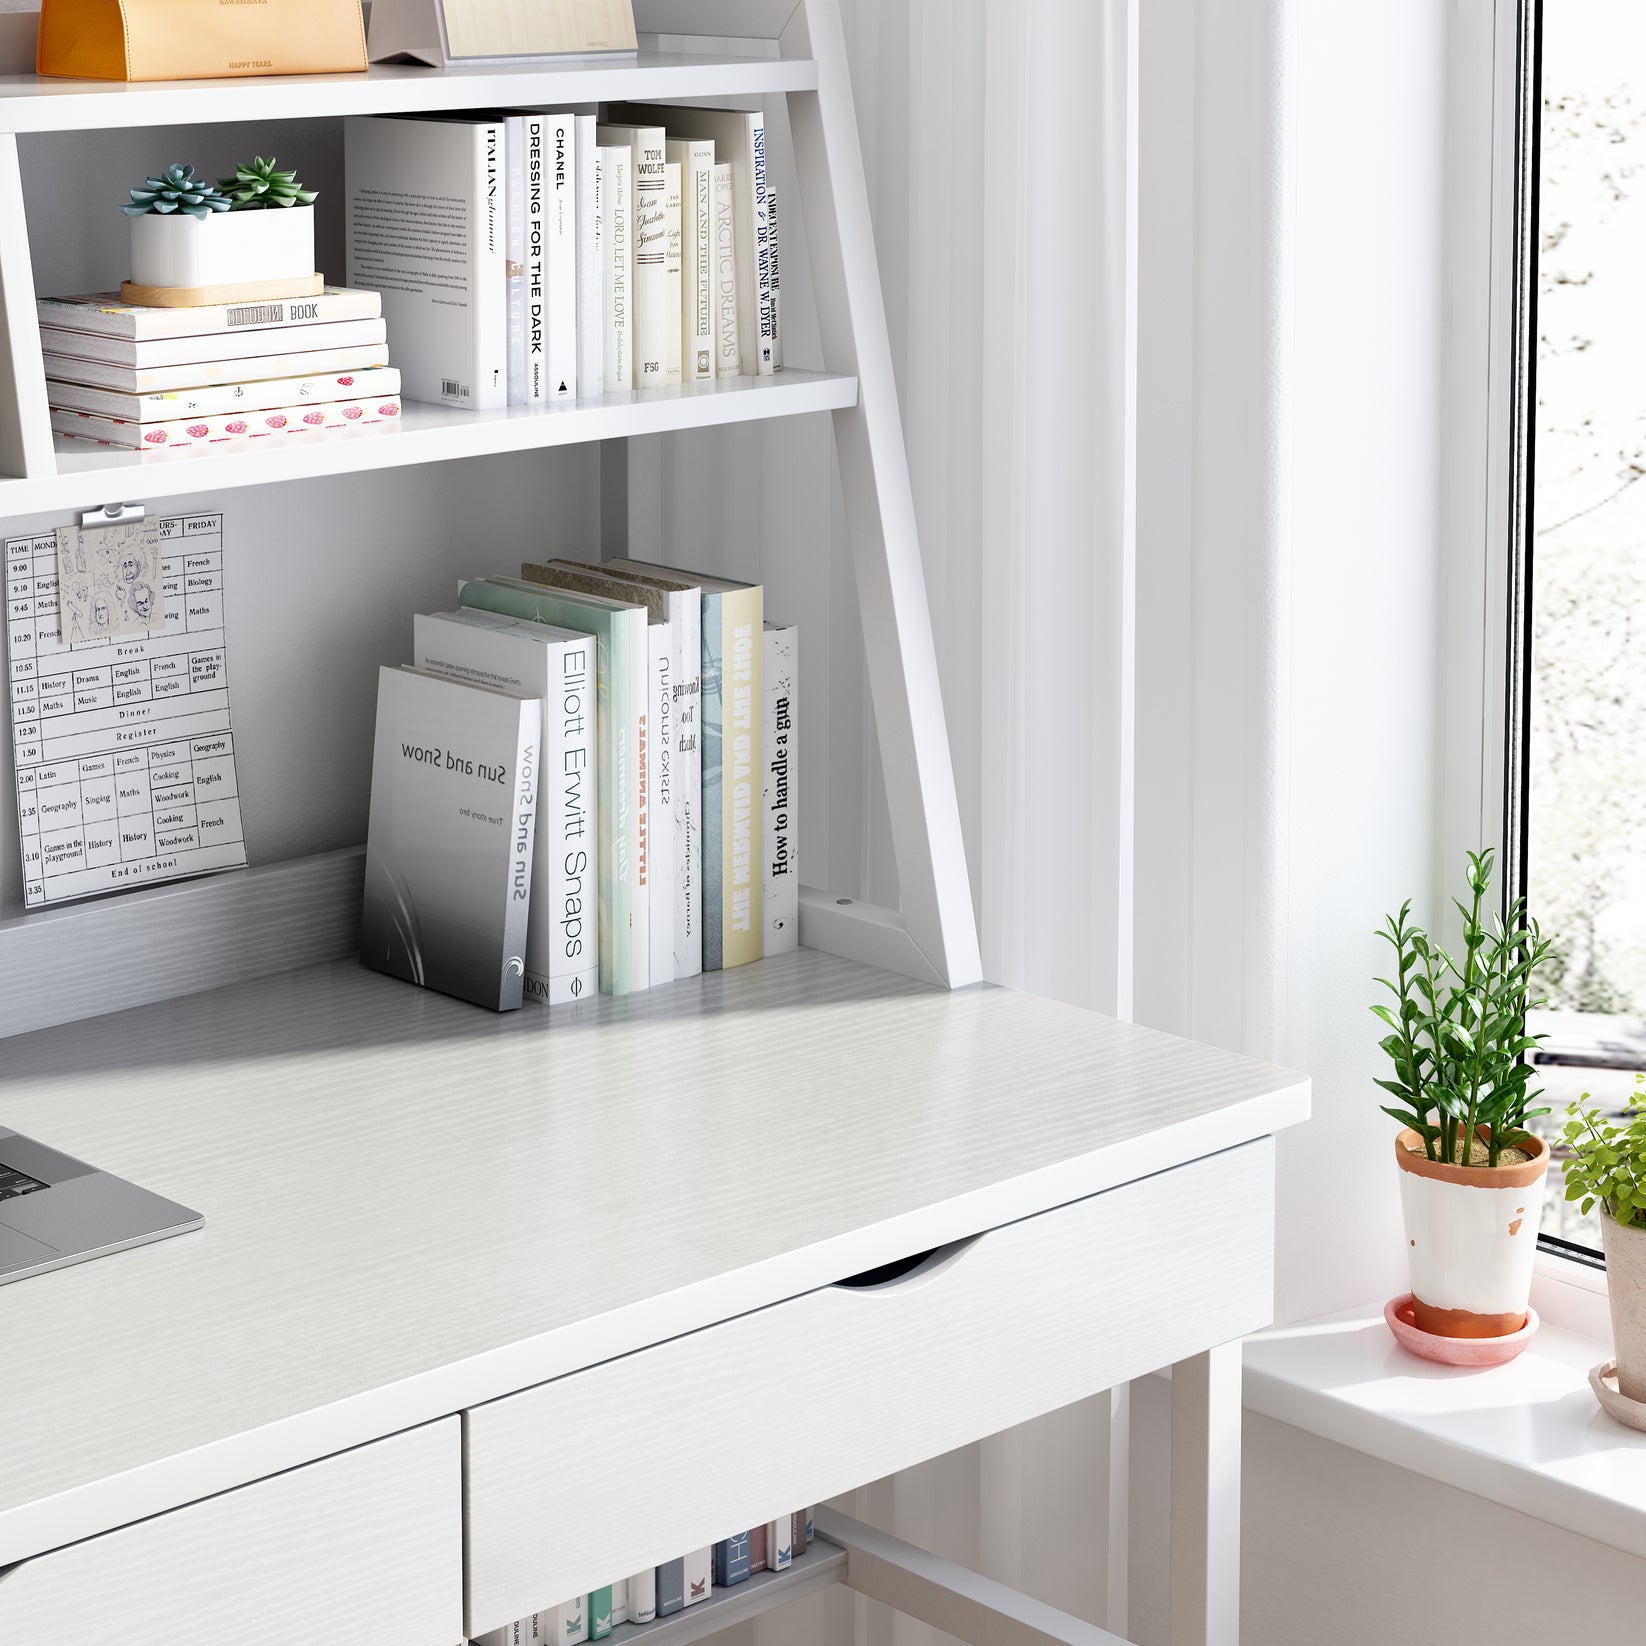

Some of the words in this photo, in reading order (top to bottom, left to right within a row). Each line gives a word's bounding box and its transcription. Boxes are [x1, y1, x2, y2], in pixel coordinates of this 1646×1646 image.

[556, 128, 564, 190] CHANEL
[644, 150, 662, 160] TOM
[486, 128, 497, 198] ITALIAN
[530, 124, 540, 214] DRESSING
[638, 163, 664, 174] WOLFE
[754, 128, 766, 204] INSPIRATION
[768, 194, 778, 241] INDECENT
[613, 209, 624, 245] LORD,
[530, 220, 541, 257] FOR
[718, 201, 733, 274] ARCTIC
[758, 227, 768, 246] DR.
[614, 248, 624, 273] LET
[758, 248, 769, 289] WAYNE
[531, 262, 541, 298] THE
[614, 274, 624, 293] ME
[760, 291, 770, 304] W.
[512, 263, 521, 346] CULTURE
[290, 304, 318, 320] BOOK
[614, 296, 624, 328] LOVE
[718, 281, 737, 358] DREAMS
[760, 307, 771, 338] DYER
[531, 304, 542, 354] DARK
[644, 362, 659, 372] FSG
[160, 521, 177, 529] URS-
[188, 520, 217, 530] FRIDAY
[10, 545, 29, 554] TIME
[34, 541, 57, 550] MOND
[13, 564, 28, 572] 9.00
[187, 559, 210, 567] French
[188, 578, 213, 587] Biology
[14, 585, 28, 593] 9.10
[14, 604, 28, 612] 9.45
[37, 600, 58, 609] Maths
[189, 607, 210, 616] Maths
[14, 633, 32, 643] 10.20
[39, 629, 61, 639] French
[117, 646, 146, 656] Break
[191, 656, 214, 664] Games
[115, 666, 140, 679] English
[153, 661, 176, 672] French
[76, 674, 100, 684] Drama
[193, 671, 216, 683] ground
[16, 684, 34, 695] 11.15
[41, 680, 66, 691] History
[155, 681, 180, 693] English
[116, 687, 142, 699] English
[564, 650, 586, 738] Elliott
[78, 695, 98, 705] Music
[17, 706, 36, 716] 11.50
[42, 701, 64, 712] Maths
[119, 708, 151, 719] Dinner
[777, 697, 790, 730] gun
[18, 726, 37, 736] 12.30
[116, 728, 157, 741] Register
[777, 734, 788, 744] a
[22, 748, 37, 758] 1.50
[193, 741, 226, 753] Geography
[117, 755, 140, 766] French
[151, 749, 176, 761] Physics
[82, 762, 105, 772] Games
[19, 774, 34, 784] 2.00
[39, 770, 56, 780] Latin
[152, 770, 179, 782] Cooking
[196, 773, 222, 786] English
[772, 749, 788, 810] handle
[119, 788, 140, 799] Maths
[155, 790, 189, 802] Woodwork
[564, 748, 586, 840] Erwitt
[85, 794, 111, 806] Singing
[22, 807, 36, 817] 2.35
[41, 801, 78, 814] Geography
[157, 814, 184, 826] Cooking
[201, 817, 224, 829] French
[774, 813, 788, 834] to
[88, 838, 112, 850] History
[122, 832, 148, 844] History
[158, 833, 194, 847] Woodwork
[44, 843, 65, 854] Games
[72, 840, 83, 848] the
[25, 852, 39, 862] 3.10
[45, 849, 83, 864] playground
[772, 840, 788, 877] How
[112, 868, 129, 878] End
[133, 865, 142, 874] of
[146, 859, 178, 872] school
[28, 885, 42, 895] 3.35
[560, 850, 587, 958] Snaps
